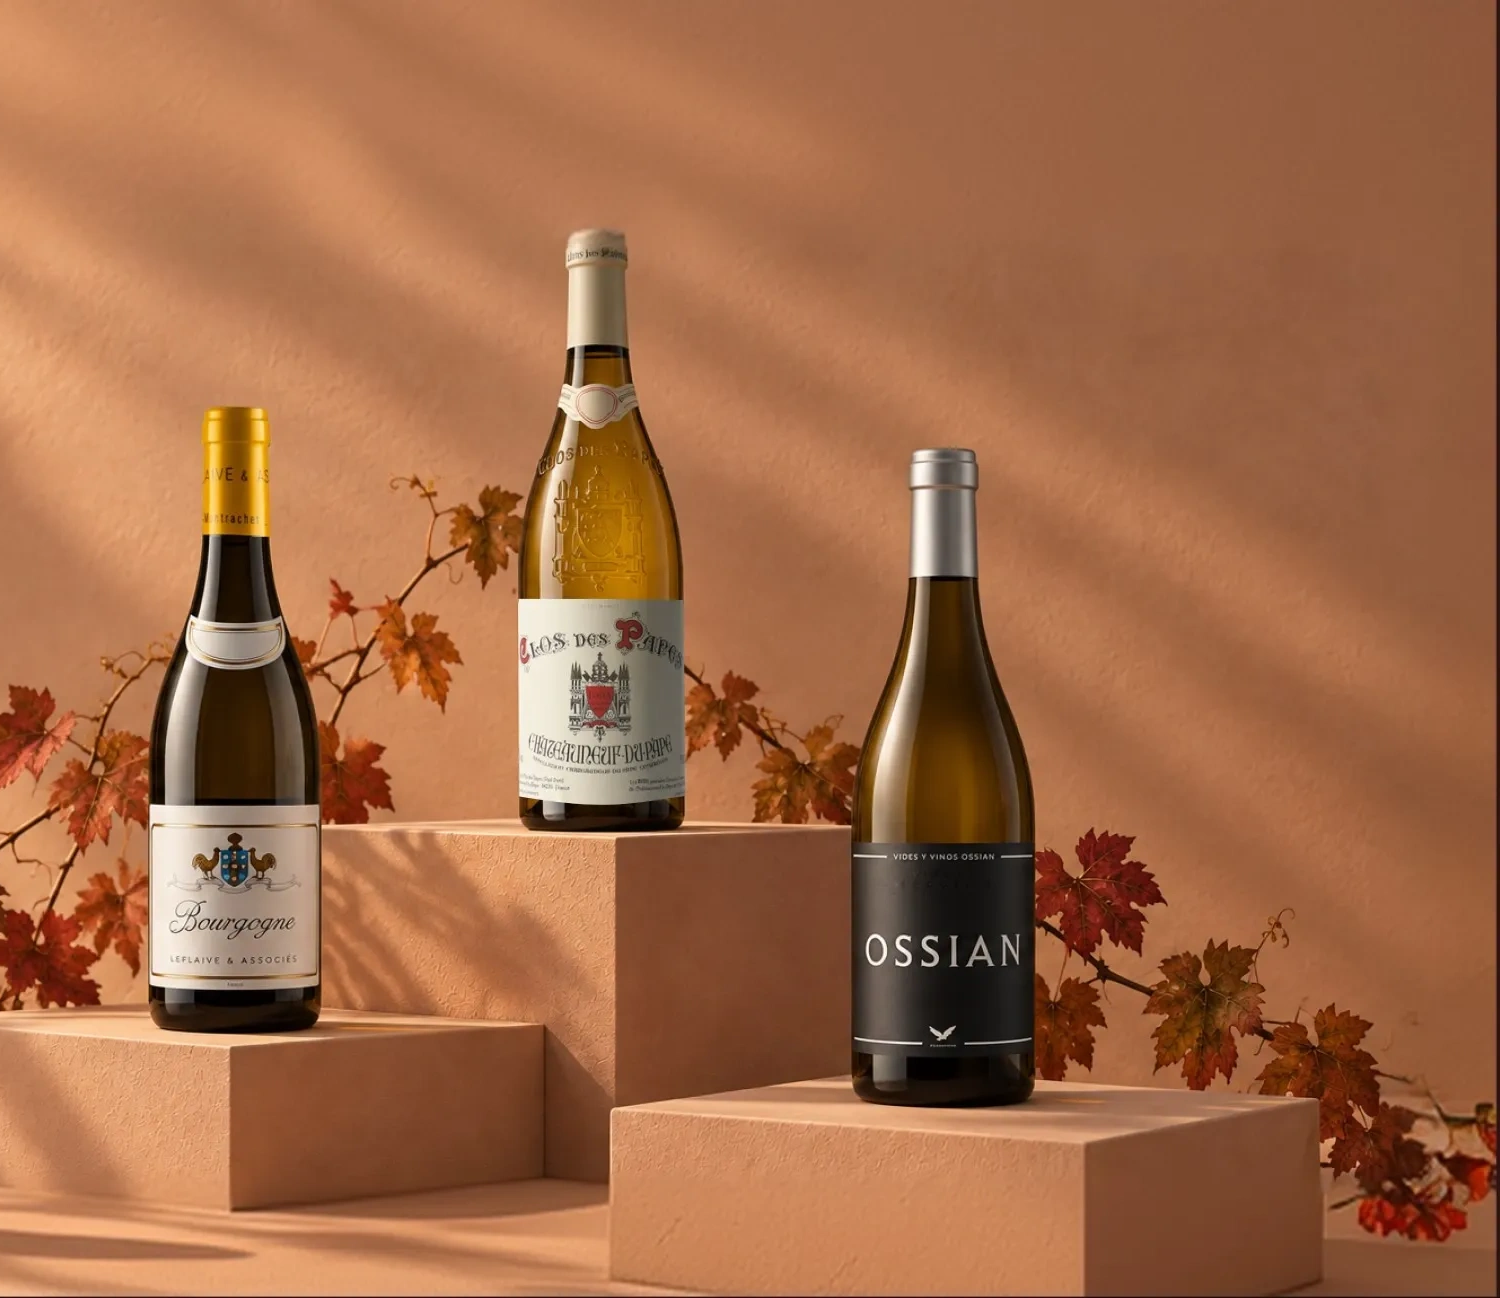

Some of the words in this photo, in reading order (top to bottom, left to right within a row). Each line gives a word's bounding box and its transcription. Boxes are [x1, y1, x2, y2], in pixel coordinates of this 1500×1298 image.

[240, 469, 248, 482] &
[573, 632, 610, 648] DES
[893, 852, 918, 861] VIDES
[921, 852, 927, 861] Y
[929, 852, 959, 861] VINOS
[961, 852, 995, 861] OSSIAN
[168, 899, 296, 940] Bourgogne
[865, 933, 1021, 968] OSSIAN
[170, 954, 220, 965] LEFLAIVE
[226, 956, 234, 965] &
[241, 954, 297, 964] ASSOCIÉS
